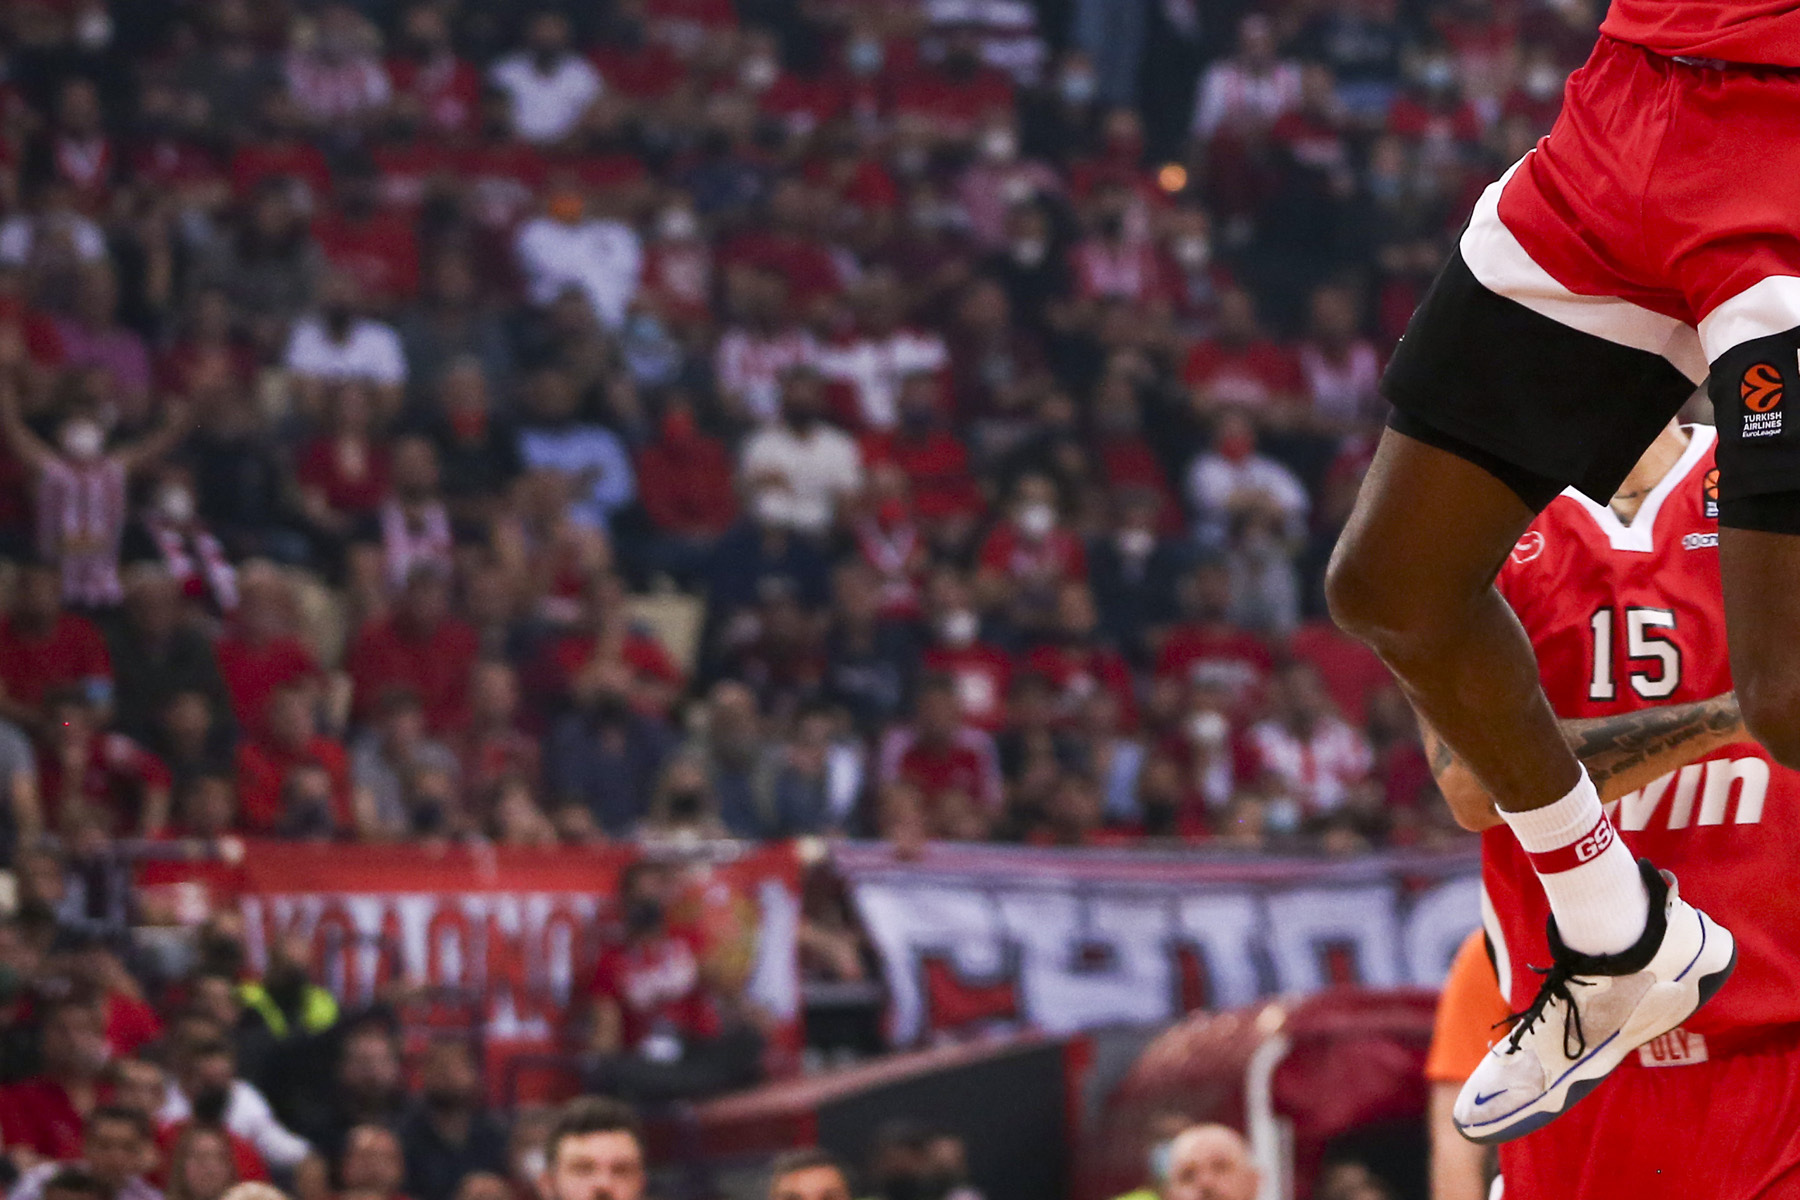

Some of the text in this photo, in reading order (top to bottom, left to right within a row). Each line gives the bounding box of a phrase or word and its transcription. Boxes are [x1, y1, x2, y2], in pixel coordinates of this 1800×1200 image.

[1743, 411, 1782, 421] TURKISH
[1743, 420, 1782, 431] AIRLINES
[1742, 428, 1782, 438] EuroLeague
[1588, 605, 1682, 702] 15
[1605, 756, 1770, 831] win
[1574, 819, 1615, 863] GS
